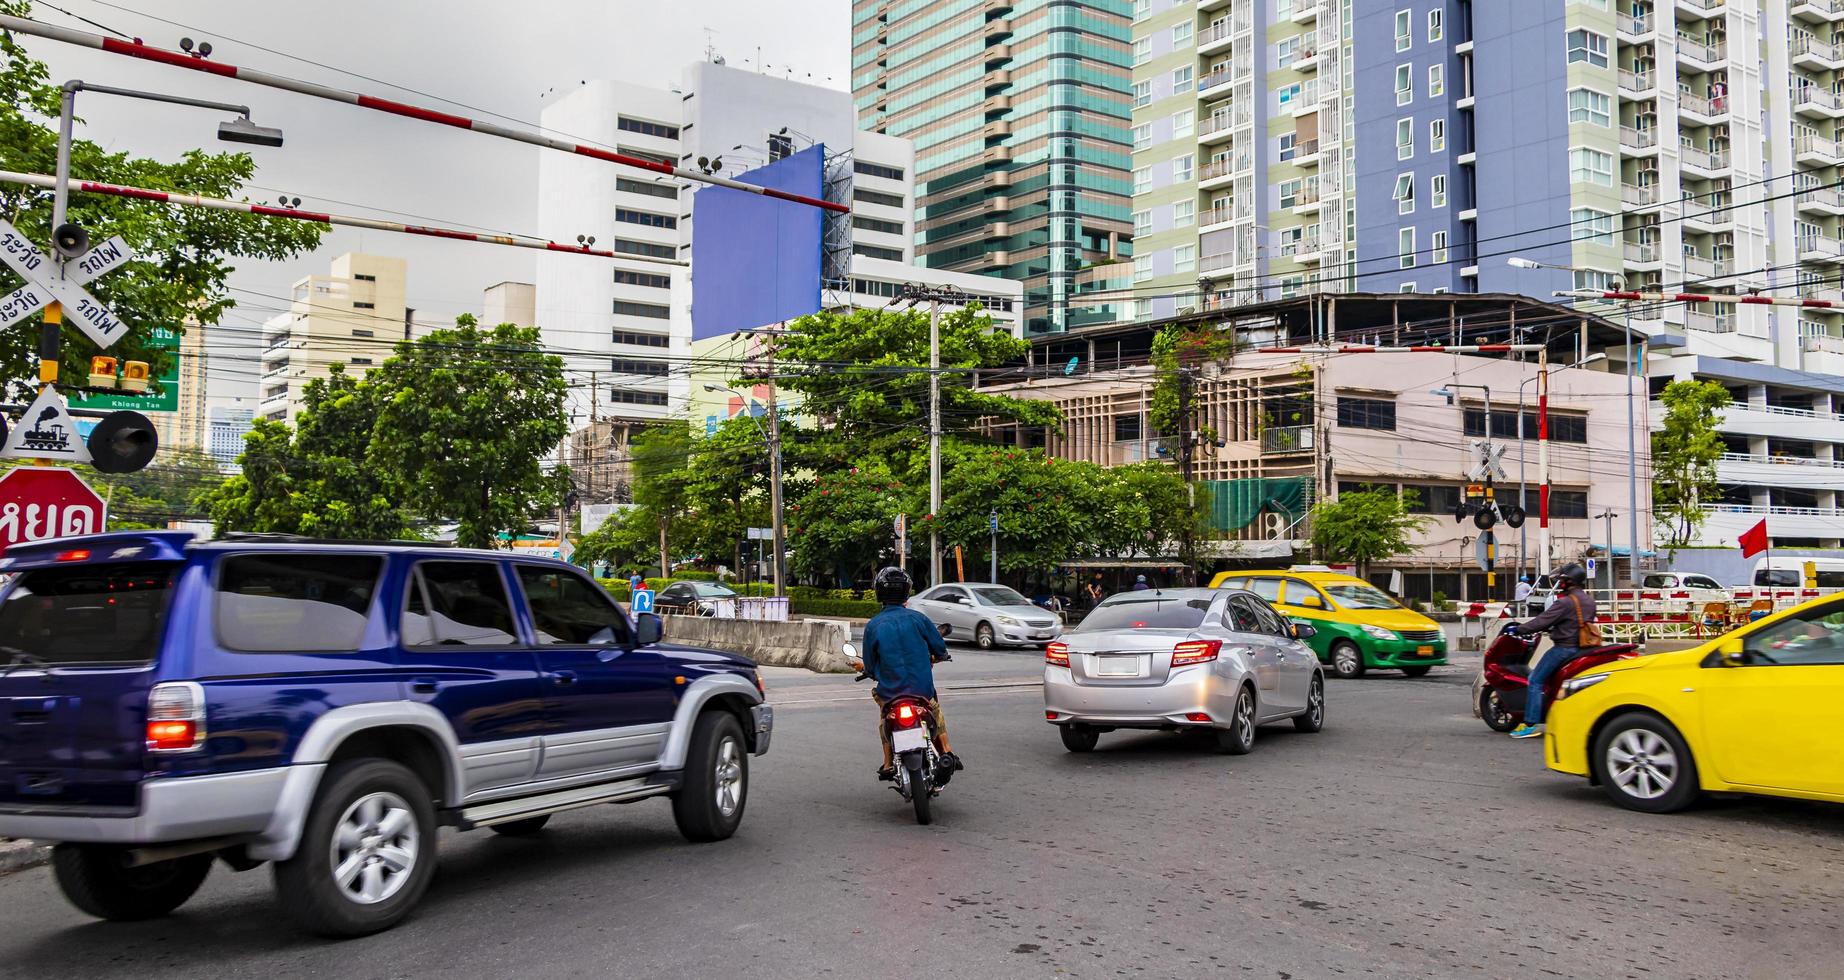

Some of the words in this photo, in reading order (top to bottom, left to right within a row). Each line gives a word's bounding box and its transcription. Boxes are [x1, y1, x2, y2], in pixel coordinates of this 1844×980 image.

[79, 240, 122, 275] รถไฟ
[1, 233, 42, 271] ระวัง
[77, 299, 120, 335] รถไฟ
[111, 400, 140, 409] Khlong
[146, 401, 160, 409] Tan
[0, 502, 94, 543] หยด
